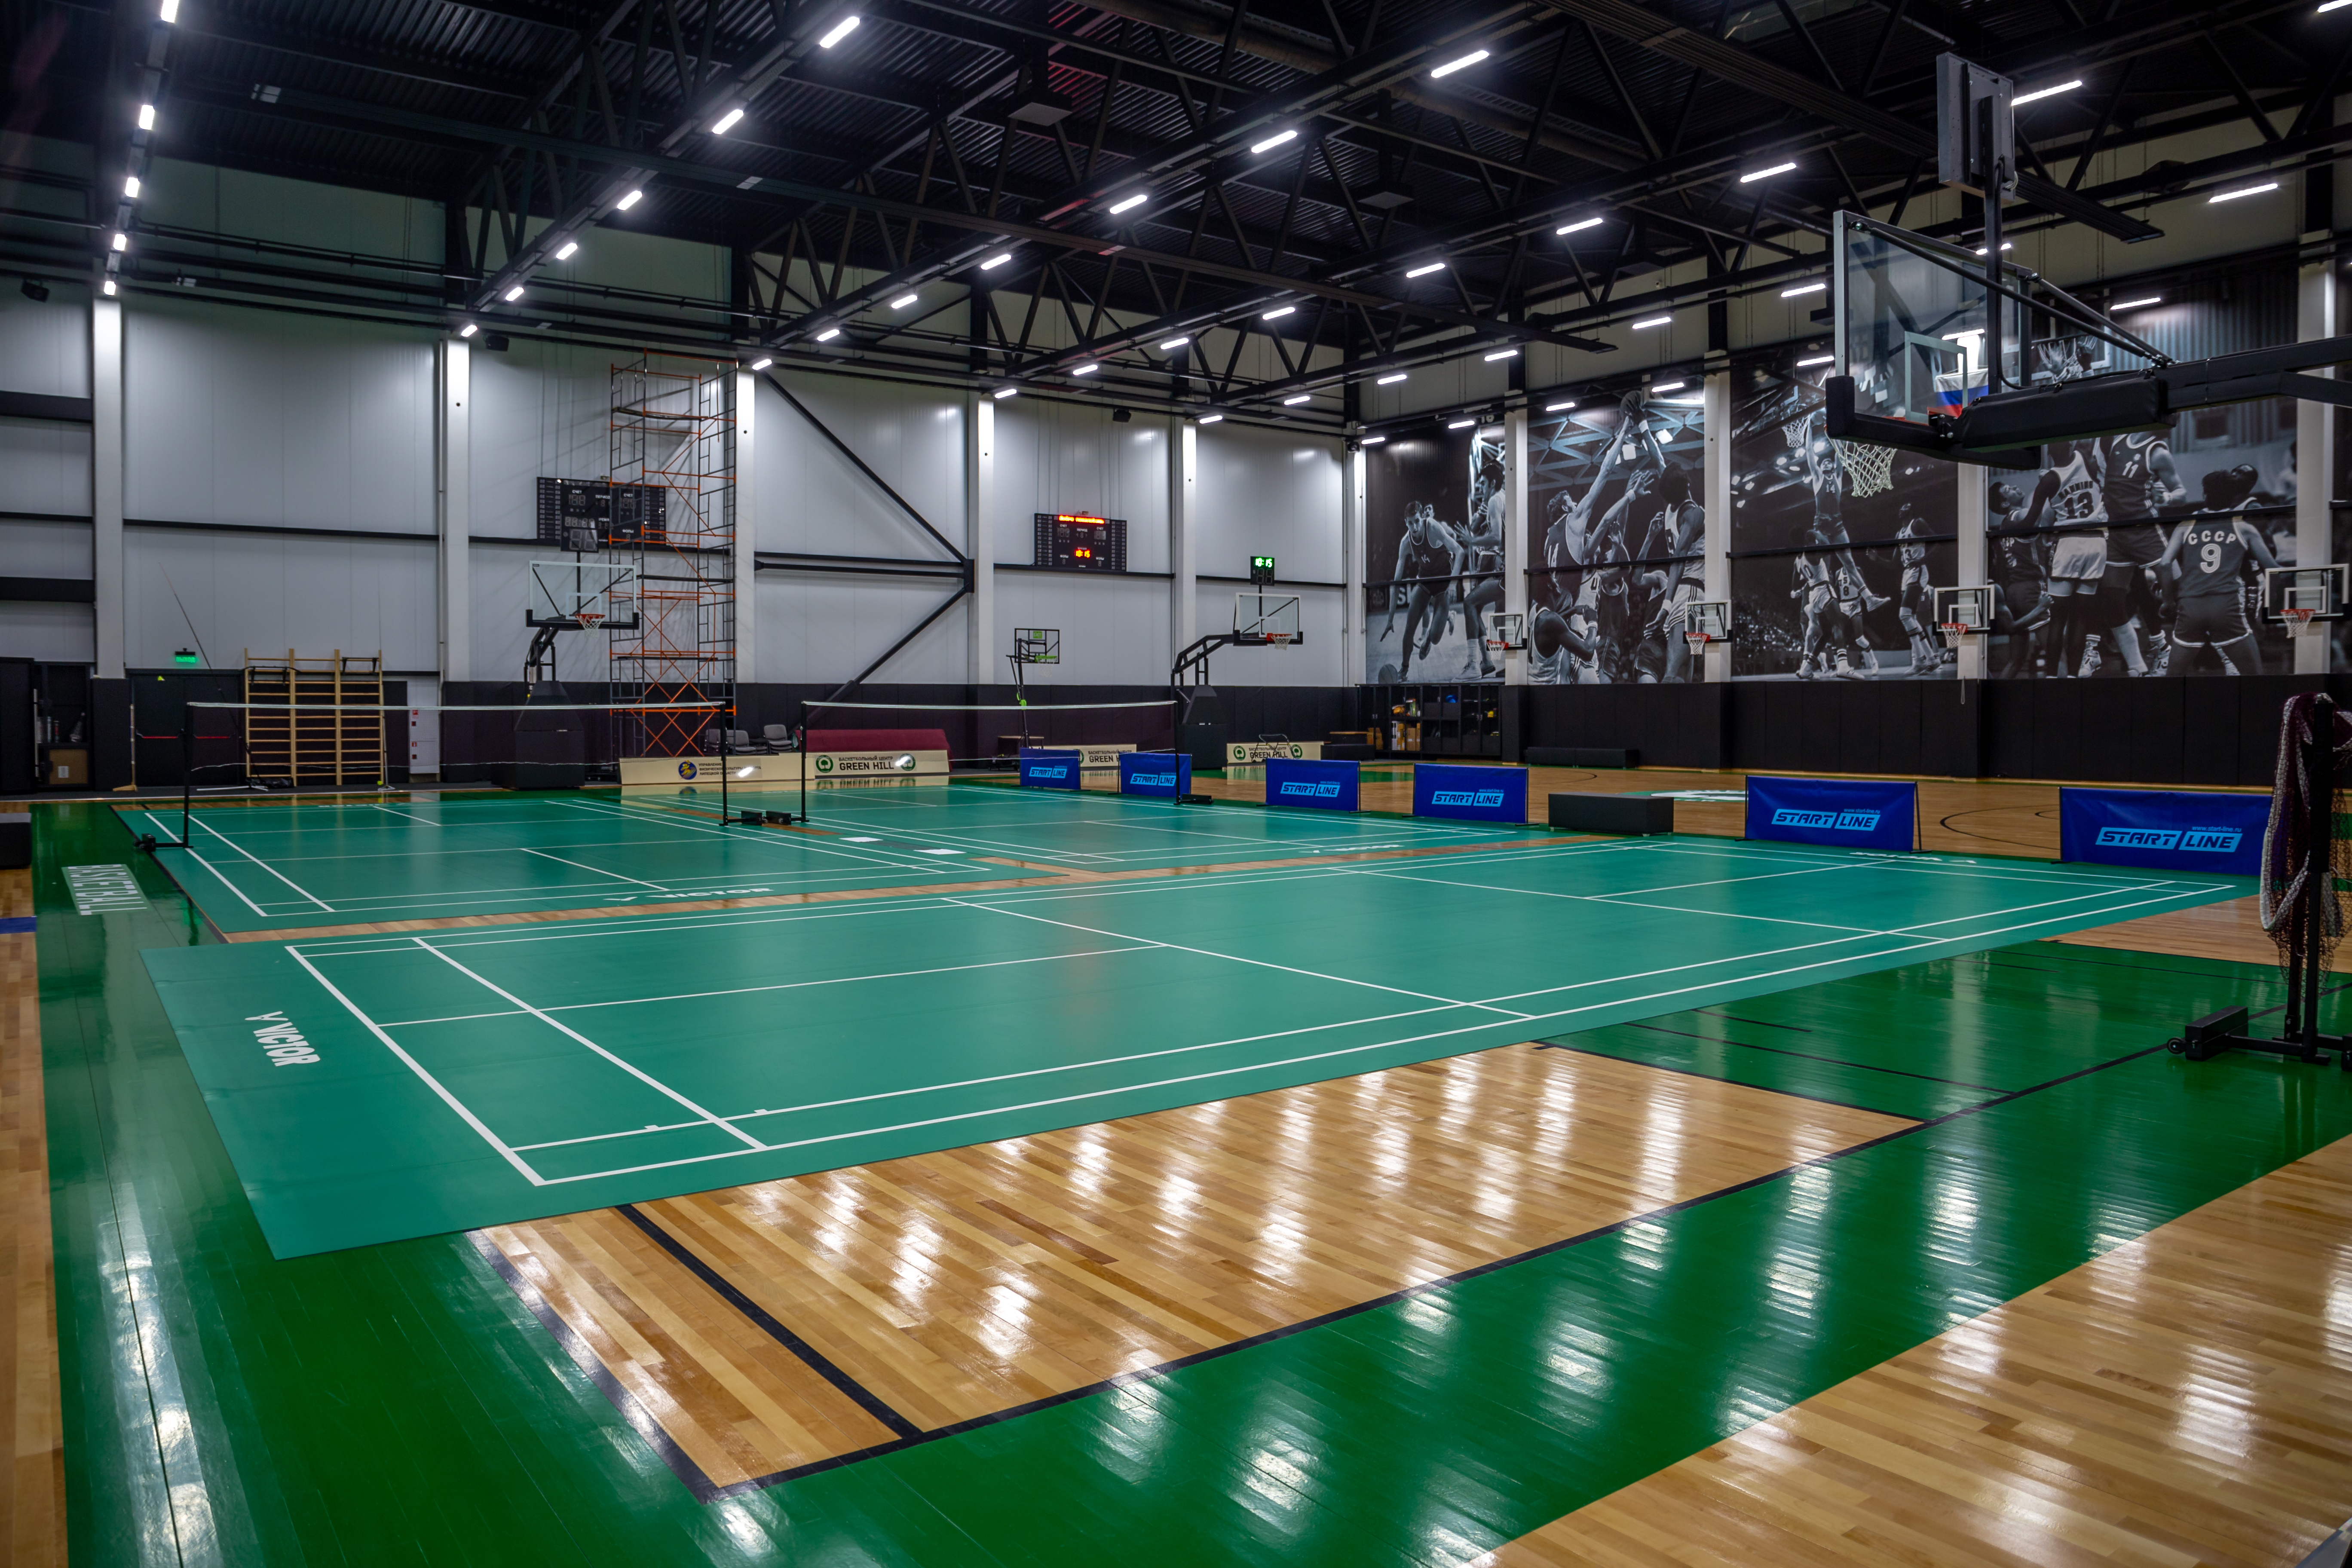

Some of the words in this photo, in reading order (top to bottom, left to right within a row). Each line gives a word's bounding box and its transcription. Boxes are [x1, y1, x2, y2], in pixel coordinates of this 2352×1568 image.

[2122, 461, 2139, 478] 11
[1826, 484, 1835, 493] 14
[2064, 491, 2094, 519] 13
[2188, 530, 2236, 545] СССР
[2200, 543, 2221, 573] 9
[839, 762, 870, 771] GREEN
[873, 762, 894, 770] HILL
[1132, 775, 1157, 784] START
[1283, 784, 1314, 794] START
[1317, 786, 1338, 795] LINE
[1434, 793, 1472, 803] START
[1476, 795, 1501, 805] LINE
[1776, 812, 1834, 825] START
[1839, 816, 1874, 828] LINE
[2101, 831, 2177, 846] START
[2185, 835, 2235, 849] LINE
[67, 864, 147, 916] BASKETBALL
[646, 888, 774, 898] VICTOR
[253, 1022, 321, 1067] VICTOR
